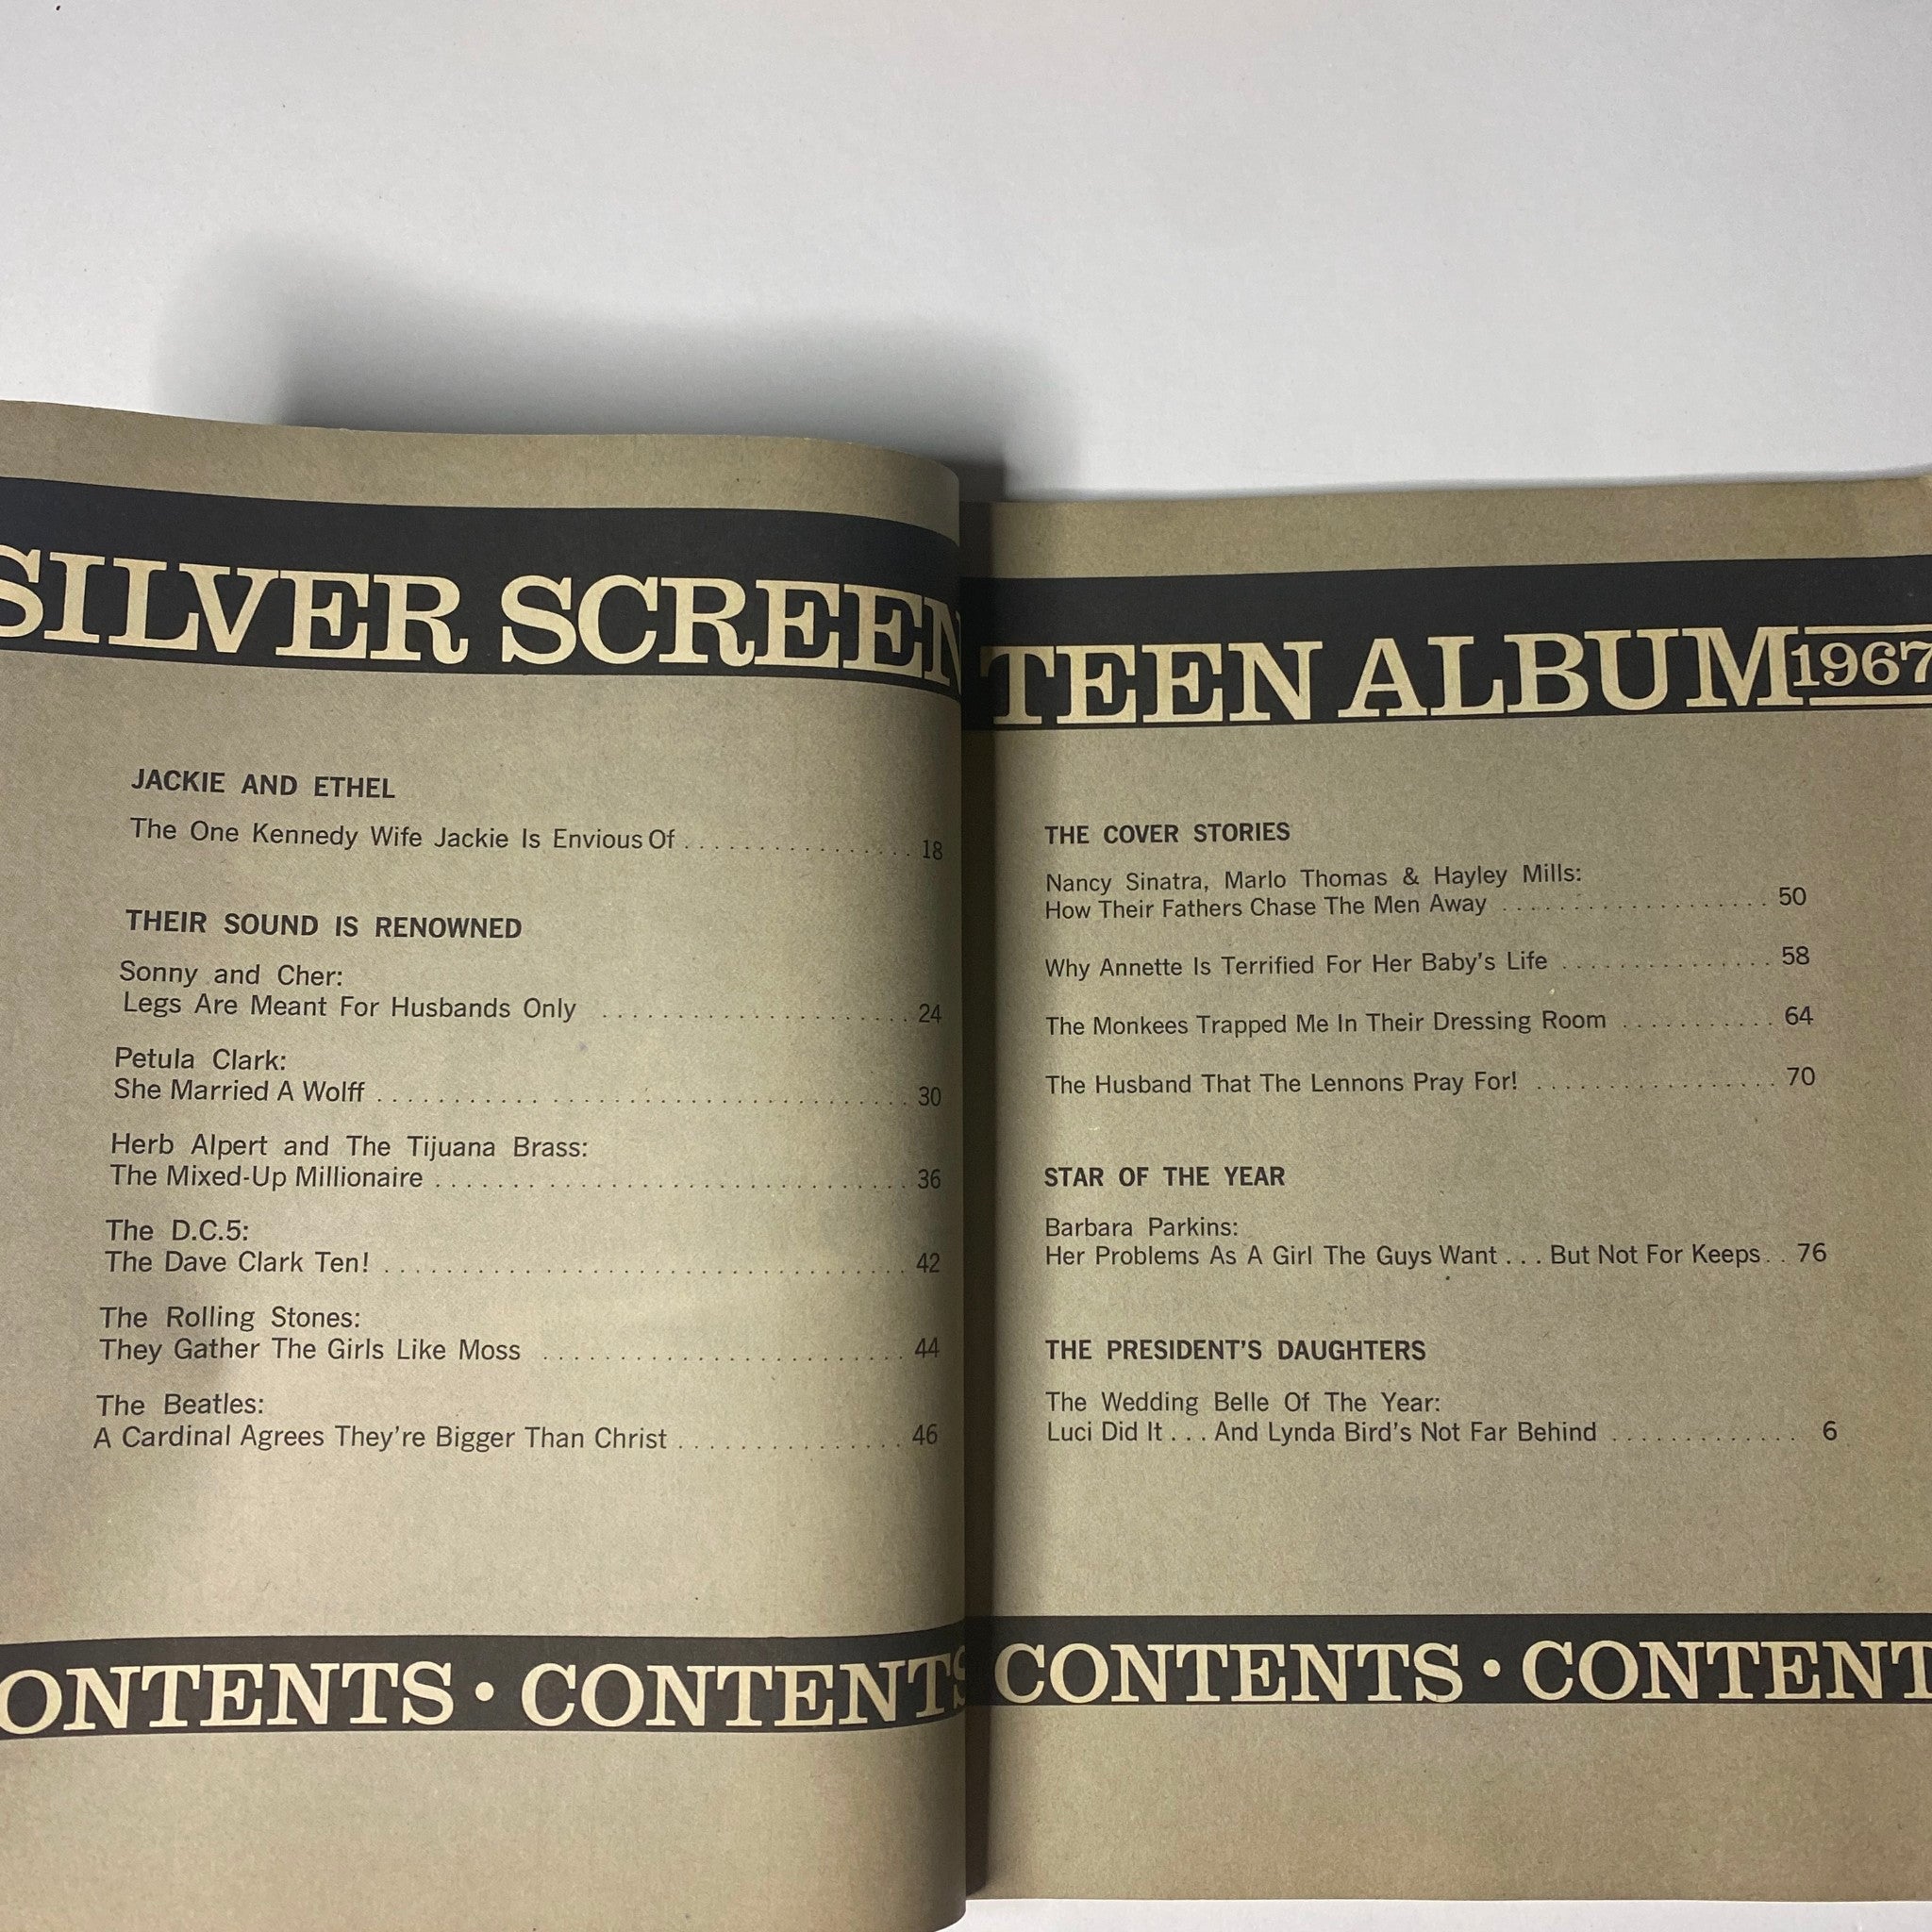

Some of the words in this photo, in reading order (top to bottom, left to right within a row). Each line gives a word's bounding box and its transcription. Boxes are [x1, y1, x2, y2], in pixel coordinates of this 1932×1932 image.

[0, 544, 468, 666] SILVER
[502, 574, 961, 696] SCREEN
[980, 643, 1323, 724] TEEN
[1338, 626, 1804, 719] ALBUM
[1790, 641, 1932, 687] 1967
[130, 768, 225, 793] JACKIE
[241, 774, 298, 796] AND
[313, 775, 396, 799] ETHEL
[129, 817, 177, 841] The
[190, 820, 240, 842] One
[253, 822, 358, 851] Kennedy
[370, 825, 423, 848] Wife
[433, 826, 509, 849] Jackie
[522, 827, 541, 849] Is
[553, 827, 643, 850] Envious
[648, 828, 675, 850] Of
[923, 839, 943, 861] 18
[1043, 824, 1090, 845] THE
[1103, 824, 1179, 844] COVER
[1193, 821, 1291, 843] STORIES
[1046, 874, 1112, 896] Nancy
[1125, 872, 1208, 893] Sinatra,
[1224, 870, 1287, 890] Marlo
[1299, 869, 1388, 888] Thomas
[1402, 866, 1420, 886] &
[1434, 864, 1508, 890] Hayley
[1523, 862, 1582, 883] Mills:
[1045, 900, 1091, 920] How
[1097, 899, 1155, 919] Their
[1162, 898, 1243, 918] Fathers
[1250, 897, 1317, 917] Chase
[1323, 895, 1365, 916] The
[1374, 894, 1420, 914] Men
[1429, 893, 1488, 917] Away
[1778, 886, 1807, 907] 50
[125, 908, 208, 934] THEIR
[224, 912, 319, 937] SOUND
[335, 915, 358, 938] IS
[375, 916, 523, 939] RENOWNED
[119, 959, 199, 989] Sonny
[213, 963, 260, 985] and
[277, 964, 342, 987] Cher:
[1044, 958, 1091, 982] Why
[1099, 958, 1183, 977] Annette
[1193, 957, 1211, 976] Is
[1220, 955, 1314, 975] Terrified
[1326, 954, 1362, 974] For
[1372, 953, 1413, 974] Her
[1422, 951, 1496, 976] Baby's
[1507, 950, 1548, 971] Life
[1782, 945, 1810, 966] 58
[124, 991, 182, 1019] Legs
[193, 992, 239, 1015] Are
[250, 994, 327, 1017] Meant
[341, 995, 380, 1017] For
[391, 996, 511, 1019] Husbands
[523, 997, 577, 1024] Only
[918, 1003, 942, 1024] 24
[1045, 1016, 1085, 1036] The
[1093, 1015, 1189, 1036] Monkees
[1195, 1013, 1287, 1039] Trapped
[1296, 1013, 1329, 1033] Me
[1338, 1013, 1357, 1033] In
[1365, 1011, 1424, 1032] Their
[1433, 1010, 1532, 1035] Dressing
[1541, 1009, 1607, 1030] Room
[1784, 1005, 1814, 1026] 64
[115, 1046, 195, 1070] Petula
[212, 1047, 286, 1071] Clark:
[113, 1077, 161, 1100] She
[171, 1078, 269, 1102] Married
[276, 1079, 294, 1102] A
[302, 1080, 366, 1103] Wolff
[918, 1085, 941, 1108] 30
[1044, 1074, 1086, 1095] The
[1095, 1074, 1191, 1094] Husband
[1200, 1074, 1252, 1093] That
[1258, 1073, 1302, 1093] The
[1310, 1073, 1405, 1092] Lennons
[1413, 1072, 1464, 1096] Pray
[1474, 1071, 1517, 1091] For!
[1786, 1066, 1816, 1087] 70
[111, 1132, 175, 1155] Herb
[190, 1133, 268, 1160] Alpert
[283, 1135, 329, 1157] and
[345, 1135, 391, 1158] The
[406, 1135, 495, 1162] Tijuana
[513, 1136, 588, 1158] Brass:
[109, 1163, 158, 1187] The
[166, 1164, 287, 1192] Mixed-Up
[295, 1165, 424, 1188] Millionaire
[917, 1168, 941, 1190] 36
[1043, 1166, 1105, 1188] STAR
[1118, 1166, 1149, 1188] OF
[1162, 1166, 1210, 1187] THE
[1224, 1165, 1286, 1187] YEAR
[105, 1218, 154, 1241] The
[172, 1219, 249, 1241] D.C.5:
[1045, 1217, 1133, 1238] Barbara
[1148, 1216, 1238, 1237] Parkins:
[104, 1250, 153, 1273] The
[165, 1250, 227, 1273] Dave
[238, 1250, 304, 1273] Clark
[314, 1251, 369, 1274] Ten!
[916, 1252, 941, 1274] 42
[1045, 1245, 1086, 1266] Her
[1095, 1245, 1200, 1266] Problems
[1209, 1244, 1237, 1265] As
[1247, 1244, 1263, 1265] A
[1273, 1244, 1312, 1266] Girl
[1323, 1244, 1366, 1266] The
[1376, 1244, 1432, 1271] Guys
[1438, 1244, 1498, 1265] Want
[1550, 1244, 1591, 1265] But
[1598, 1243, 1639, 1265] Not
[1646, 1243, 1684, 1264] For
[1691, 1242, 1761, 1269] Keeps
[1797, 1241, 1827, 1263] 76
[99, 1306, 148, 1329] The
[166, 1305, 256, 1333] Rolling
[271, 1305, 360, 1328] Stones:
[98, 1338, 163, 1366] They
[174, 1337, 260, 1360] Gather
[271, 1337, 317, 1359] The
[327, 1337, 384, 1360] Girls
[397, 1338, 446, 1360] Like
[458, 1339, 521, 1361] Moss
[914, 1337, 941, 1359] 44
[1044, 1339, 1092, 1360] THE
[1107, 1339, 1262, 1361] PRESIDENT'S
[1277, 1340, 1426, 1361] DAUGHTERS
[95, 1394, 145, 1417] The
[164, 1391, 264, 1415] Beatles:
[1044, 1391, 1087, 1412] The
[1101, 1391, 1199, 1417] Wedding
[1214, 1391, 1270, 1412] Belle
[1284, 1391, 1310, 1412] Of
[1324, 1391, 1367, 1413] The
[1380, 1391, 1441, 1413] Year:
[92, 1426, 112, 1449] A
[122, 1424, 231, 1448] Cardinal
[240, 1424, 325, 1452] Agrees
[334, 1424, 426, 1453] They're
[436, 1425, 516, 1453] Bigger
[524, 1425, 584, 1449] Than
[594, 1426, 668, 1450] Christ
[911, 1423, 938, 1446] 46
[1047, 1421, 1092, 1442] Luci
[1102, 1420, 1138, 1441] Did
[1147, 1421, 1163, 1441] It
[1214, 1420, 1258, 1442] And
[1268, 1421, 1335, 1447] Lynda
[1344, 1421, 1412, 1442] Bird's
[1421, 1421, 1461, 1442] Not
[1471, 1421, 1508, 1442] Far
[1517, 1421, 1597, 1442] Behind
[1823, 1420, 1838, 1441] 6
[994, 1642, 1463, 1703] CONTENTS
[1522, 1640, 1932, 1702] CONTENT
